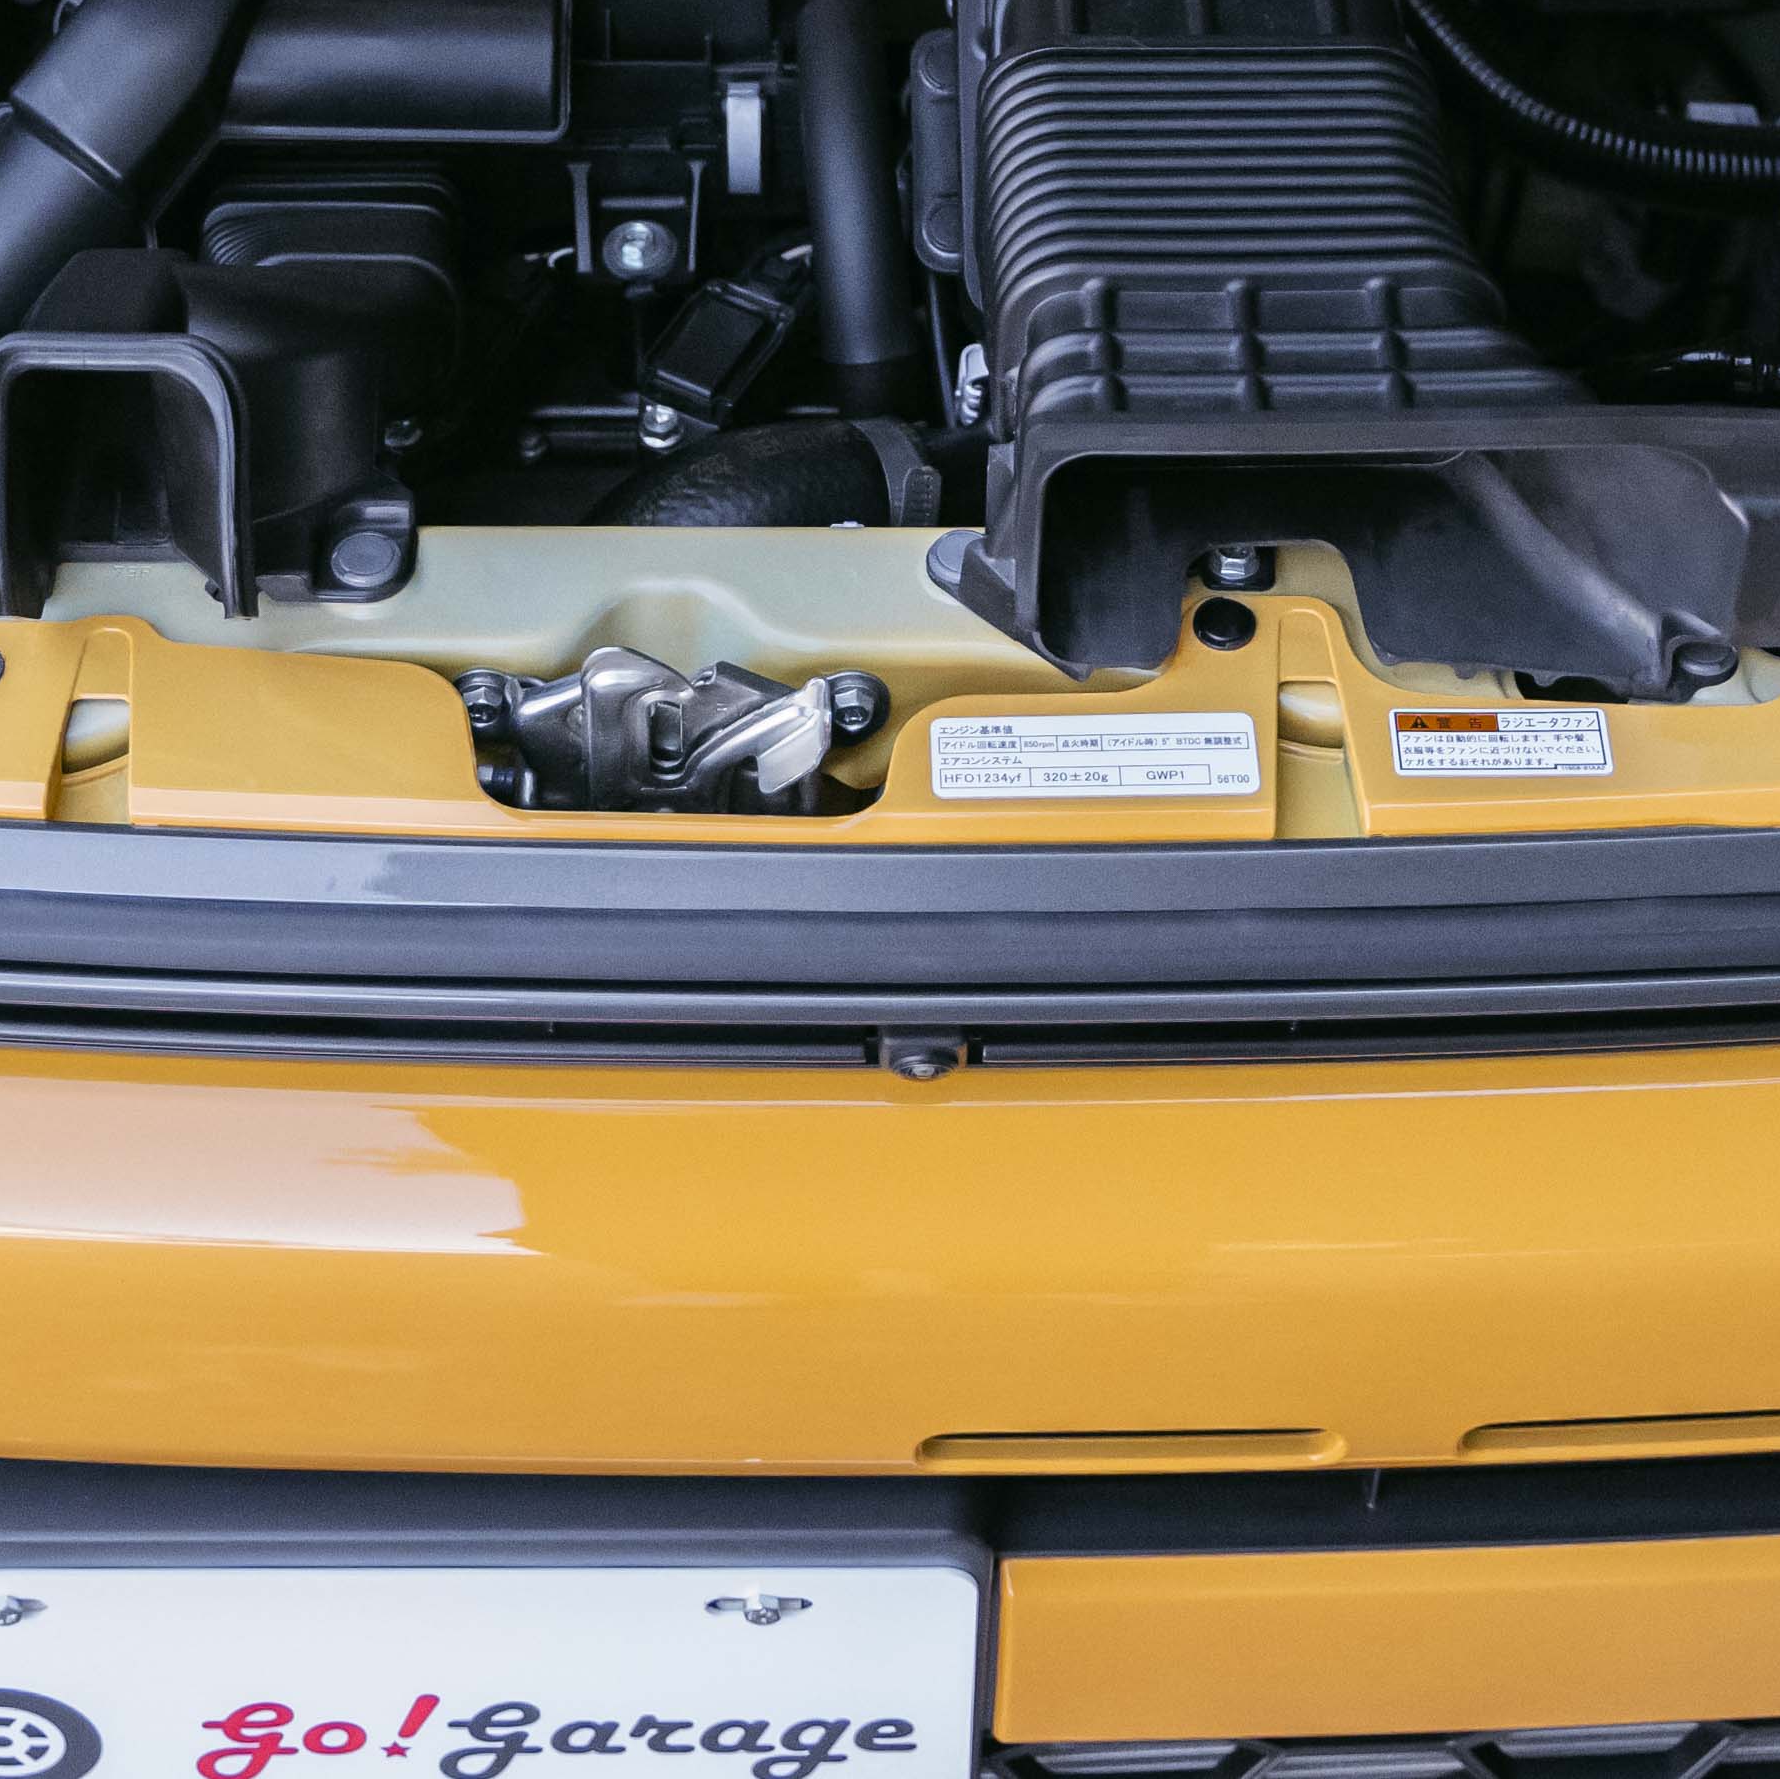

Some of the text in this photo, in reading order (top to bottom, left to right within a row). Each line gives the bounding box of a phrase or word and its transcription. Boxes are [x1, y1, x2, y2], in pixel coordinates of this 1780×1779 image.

[1500, 716, 1596, 728] ラジエータファン
[939, 725, 1014, 735] エンジン基準値
[1062, 738, 1099, 748] 点火時期
[1176, 737, 1201, 746] BTDC
[940, 755, 1023, 766] エアコンシステム
[943, 772, 1022, 784] HFO1234yf
[1145, 770, 1184, 781] GWP1
[1216, 774, 1250, 784] 56T00
